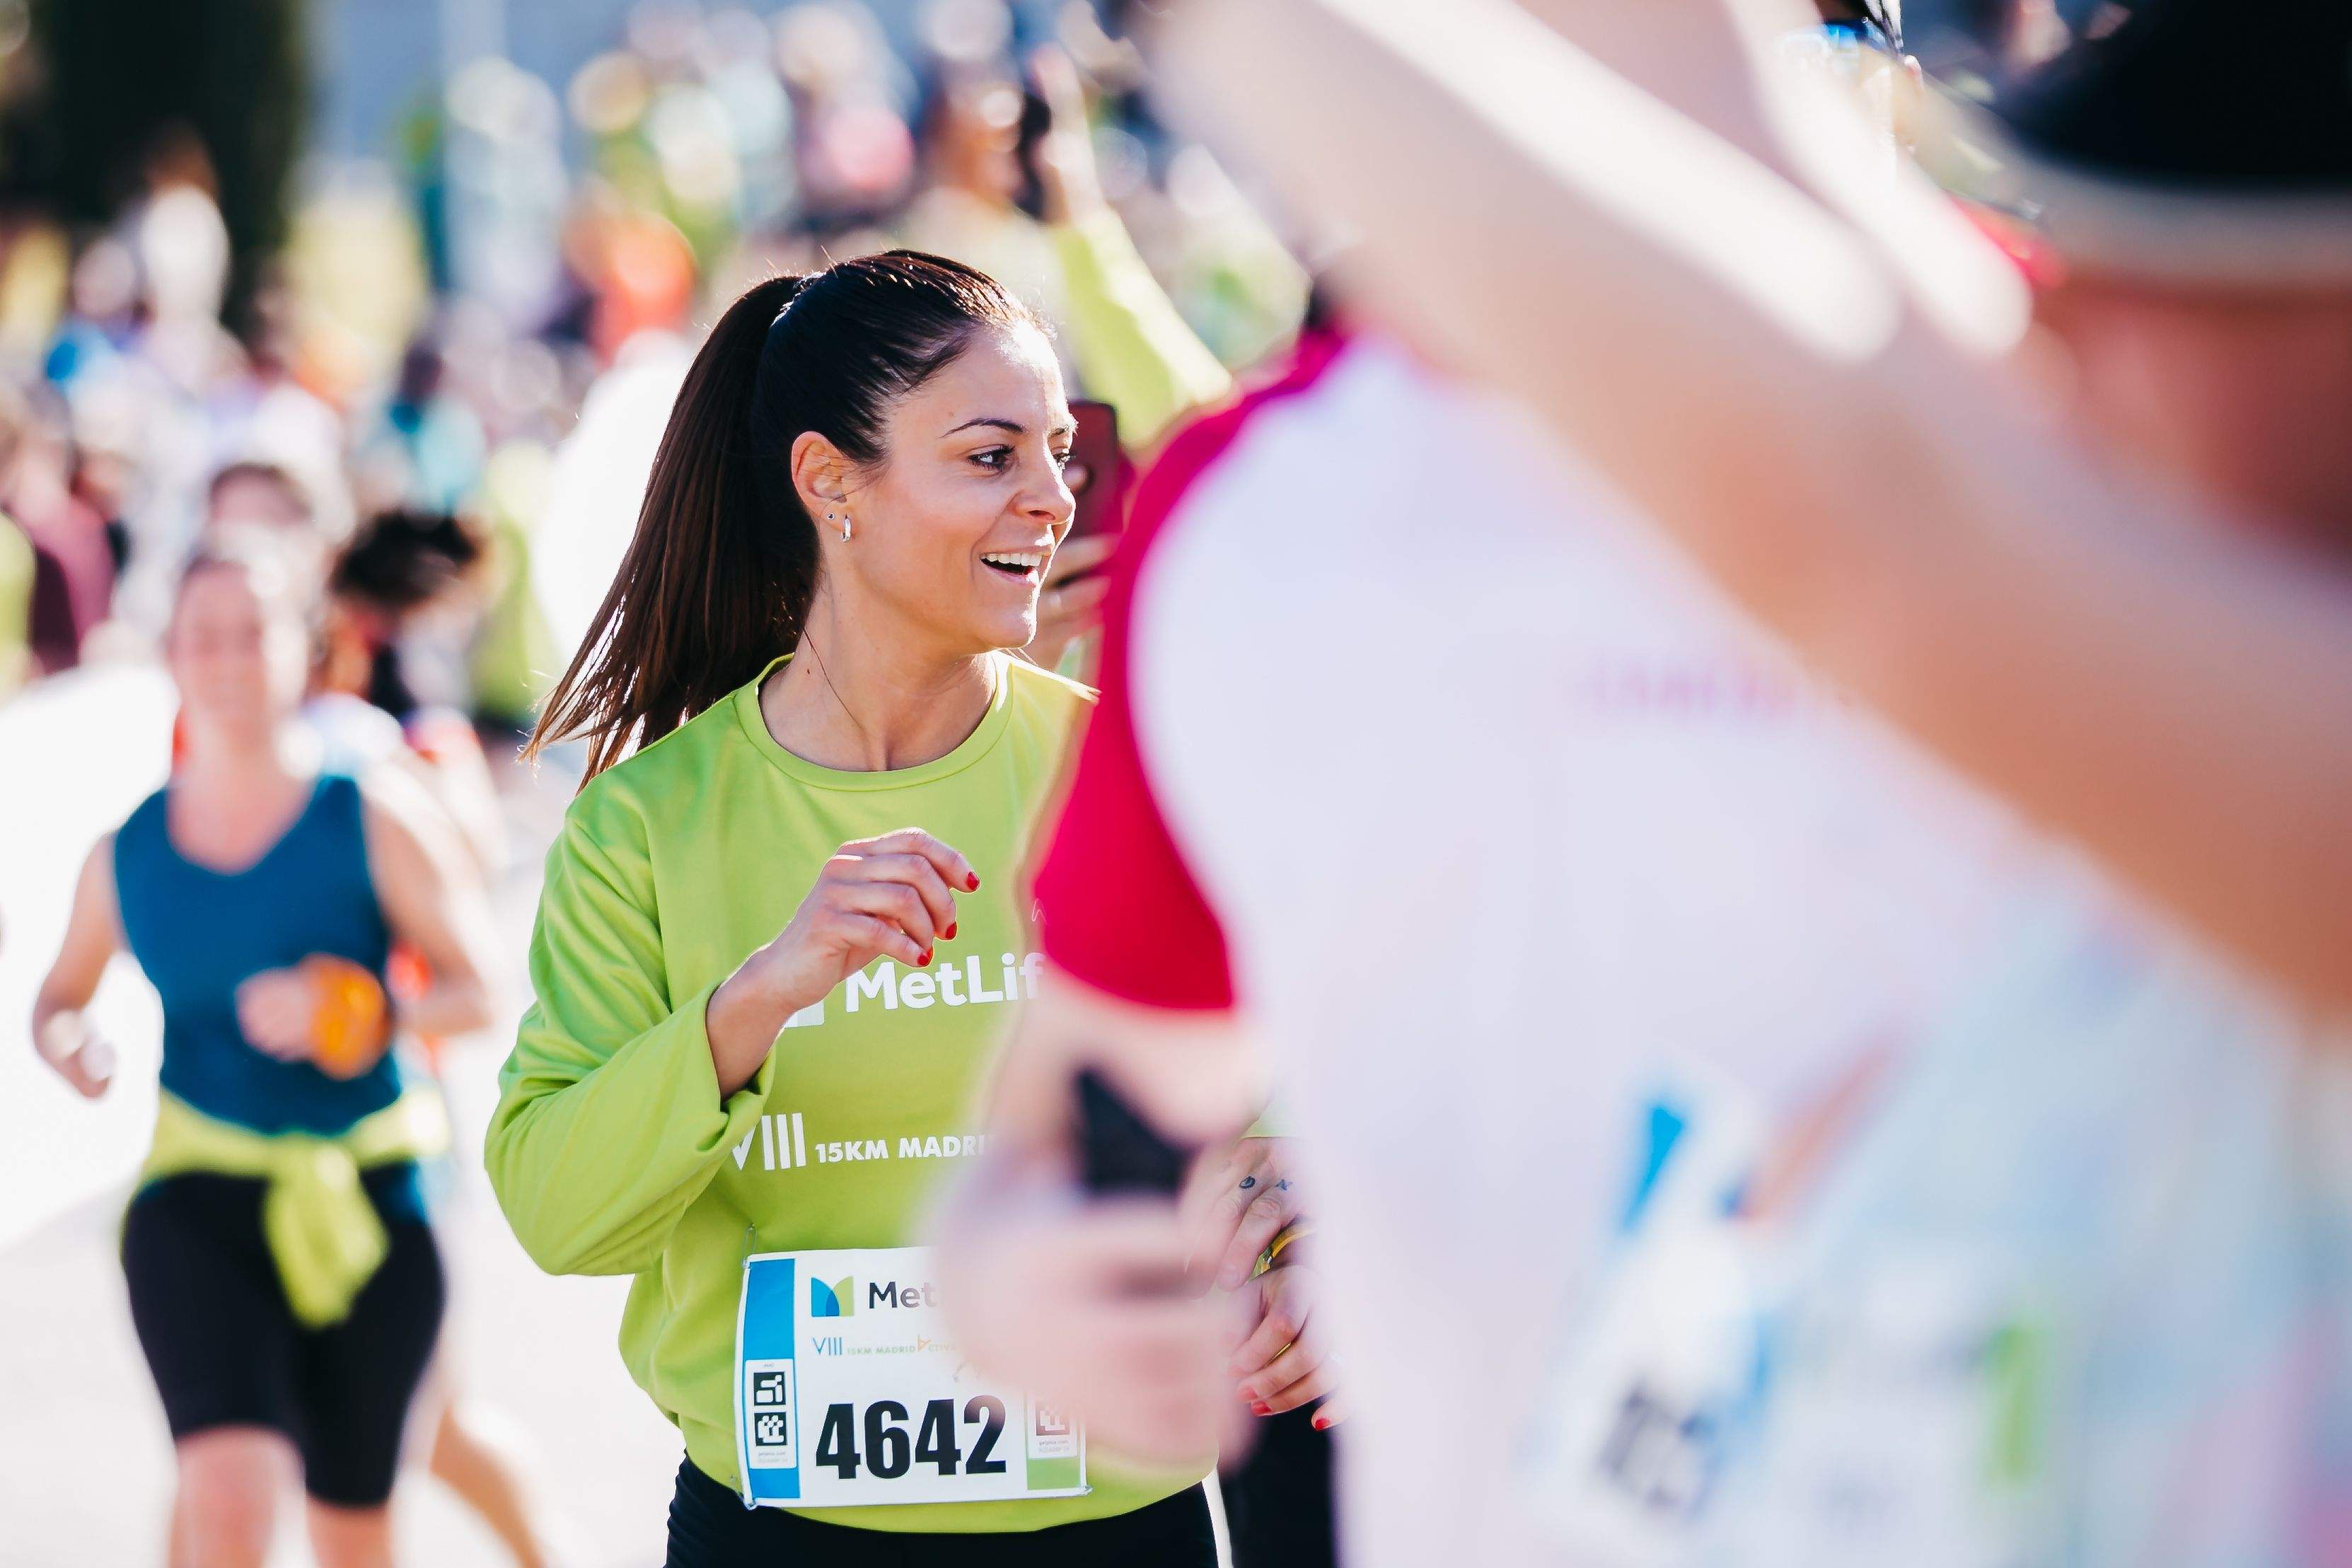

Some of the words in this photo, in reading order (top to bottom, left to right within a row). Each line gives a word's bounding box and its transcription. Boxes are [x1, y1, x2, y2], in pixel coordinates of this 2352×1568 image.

[845, 952, 1045, 1012] MetLif
[815, 1139, 888, 1163] 15KM
[898, 1134, 990, 1158] MADRI
[869, 1281, 939, 1309] Met
[813, 1337, 842, 1355] VIII
[847, 1346, 872, 1355] 15KM
[876, 1345, 915, 1354] MADRID
[816, 1395, 1007, 1480] 4642
